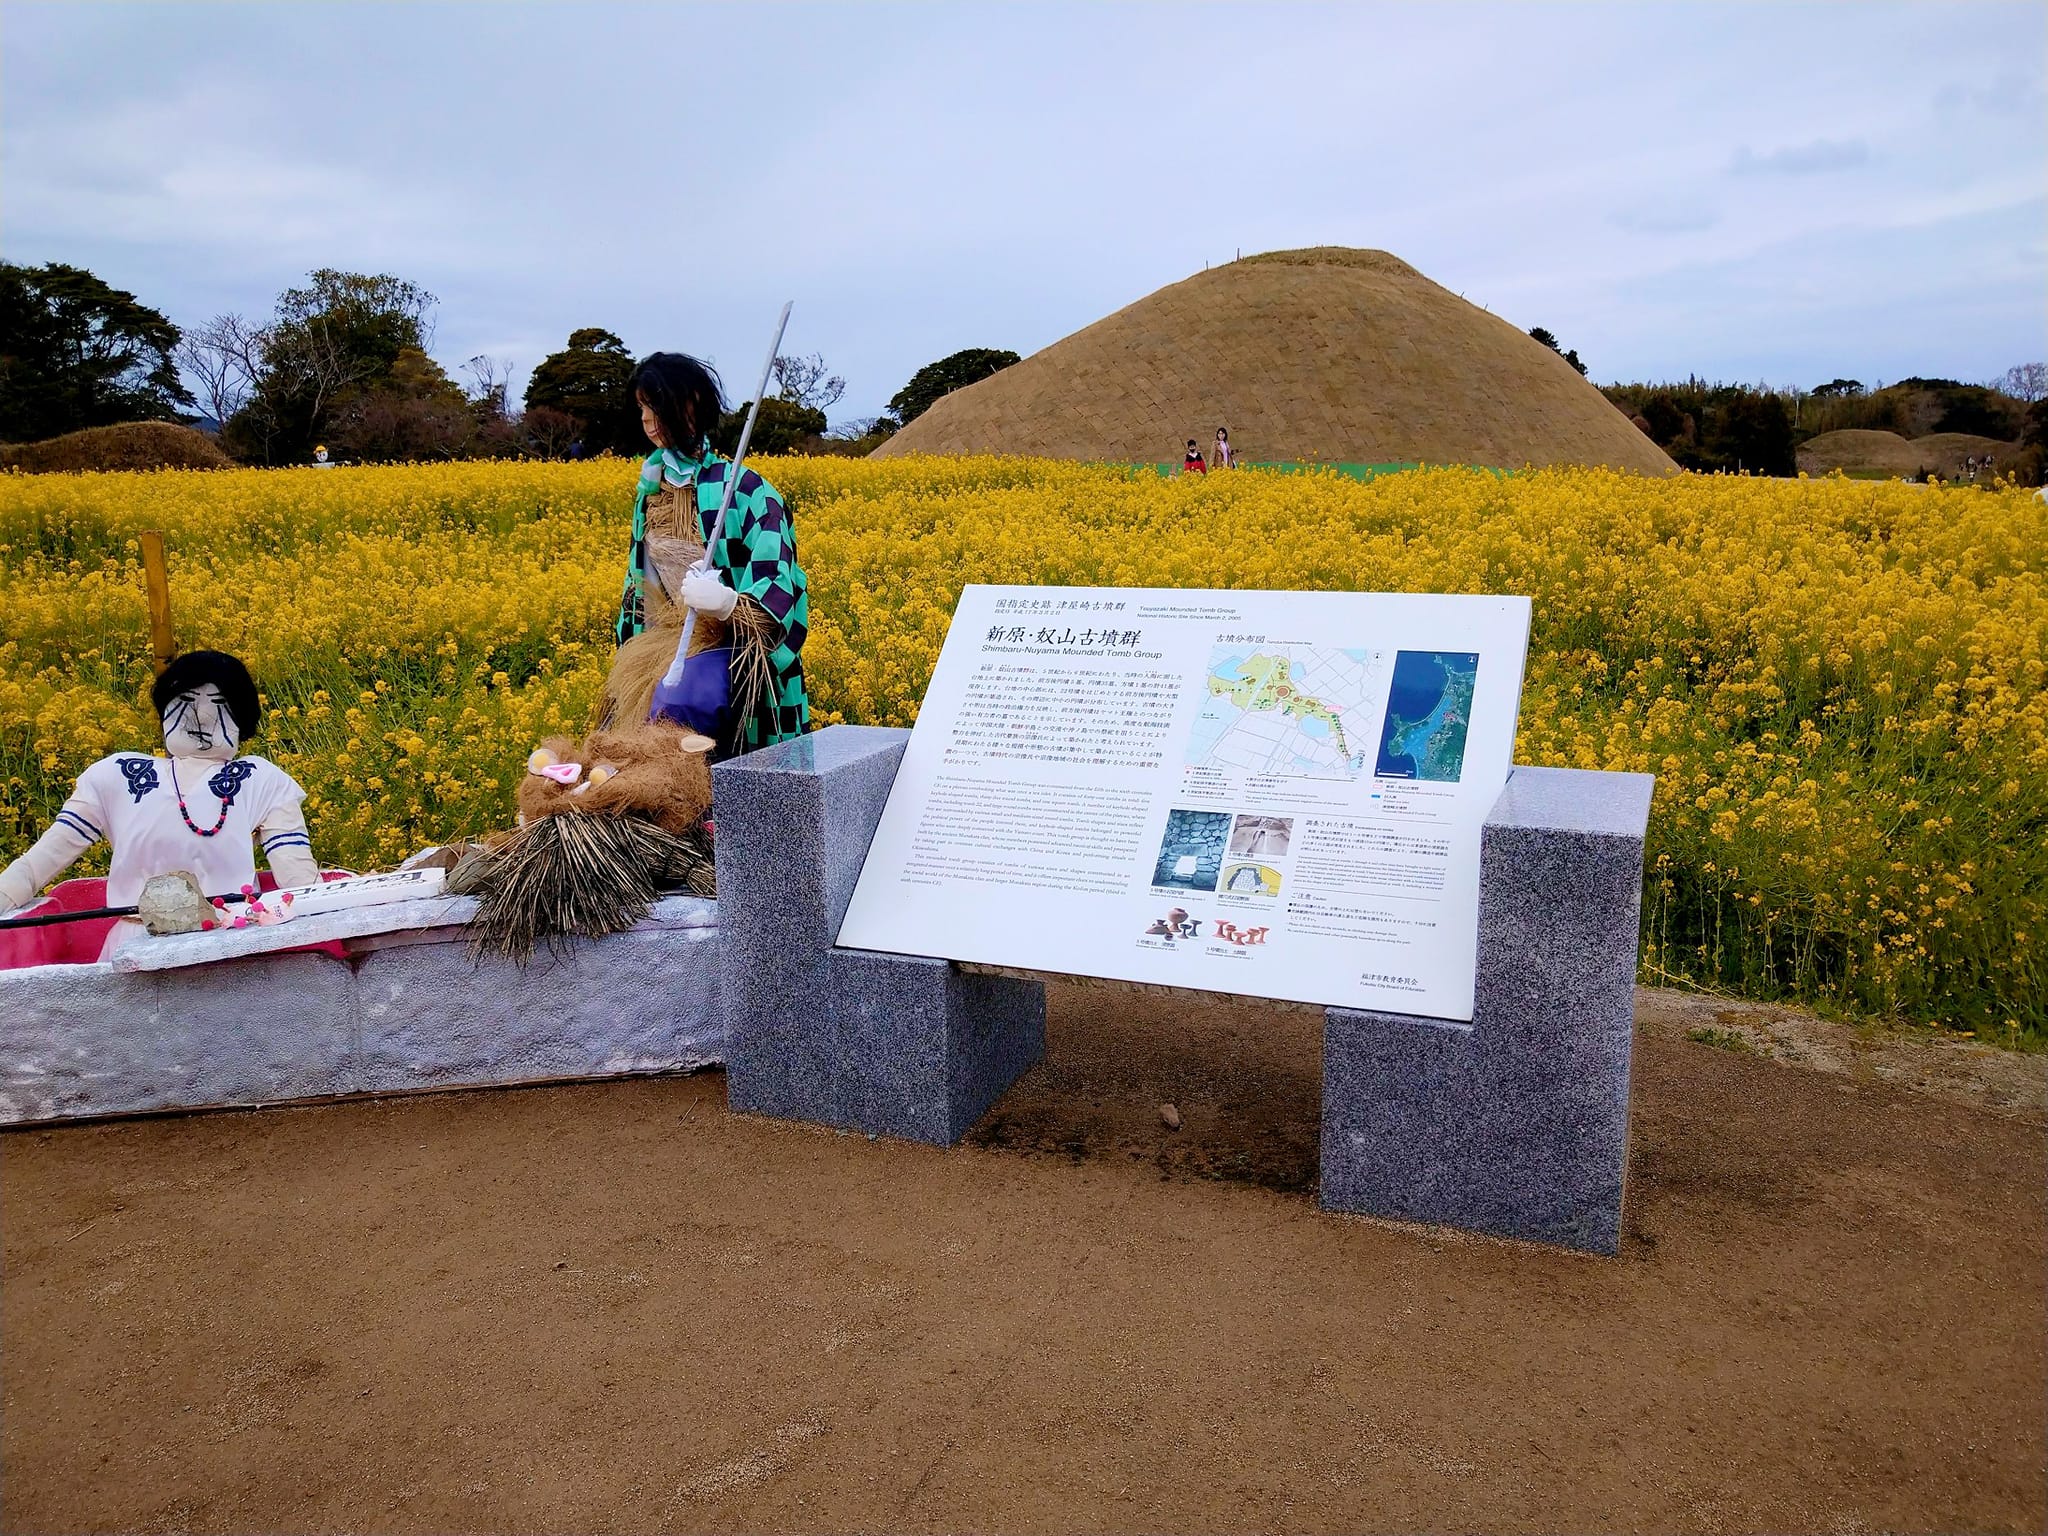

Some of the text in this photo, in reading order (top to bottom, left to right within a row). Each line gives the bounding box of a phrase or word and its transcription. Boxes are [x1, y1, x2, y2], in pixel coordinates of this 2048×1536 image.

[982, 644, 1162, 659] Shimbaru-Nuyama Mounded Tomb Group
